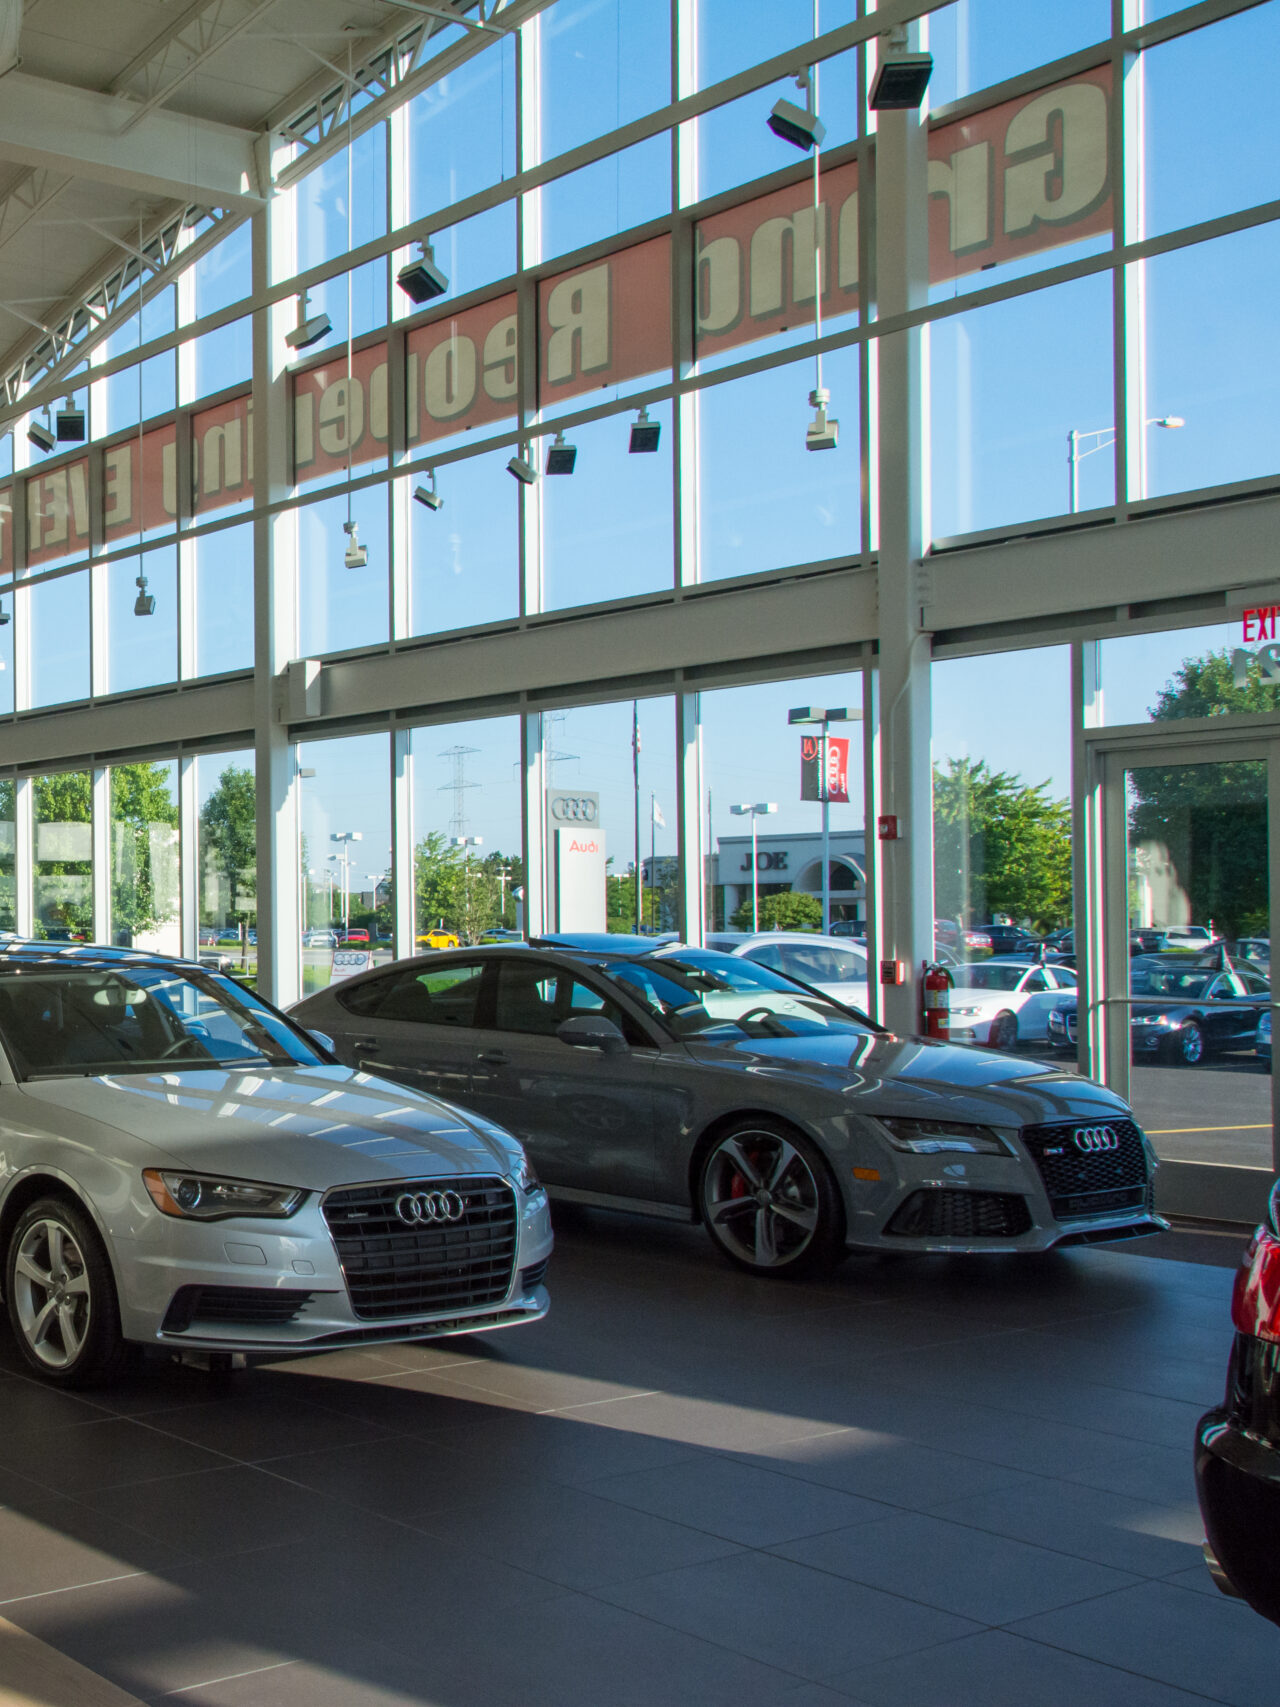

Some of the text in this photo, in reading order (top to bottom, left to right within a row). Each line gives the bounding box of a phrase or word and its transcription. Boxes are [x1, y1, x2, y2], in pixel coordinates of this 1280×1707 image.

[1243, 605, 1280, 642] EXI
[569, 840, 598, 853] Audi
[740, 852, 787, 871] JOE
